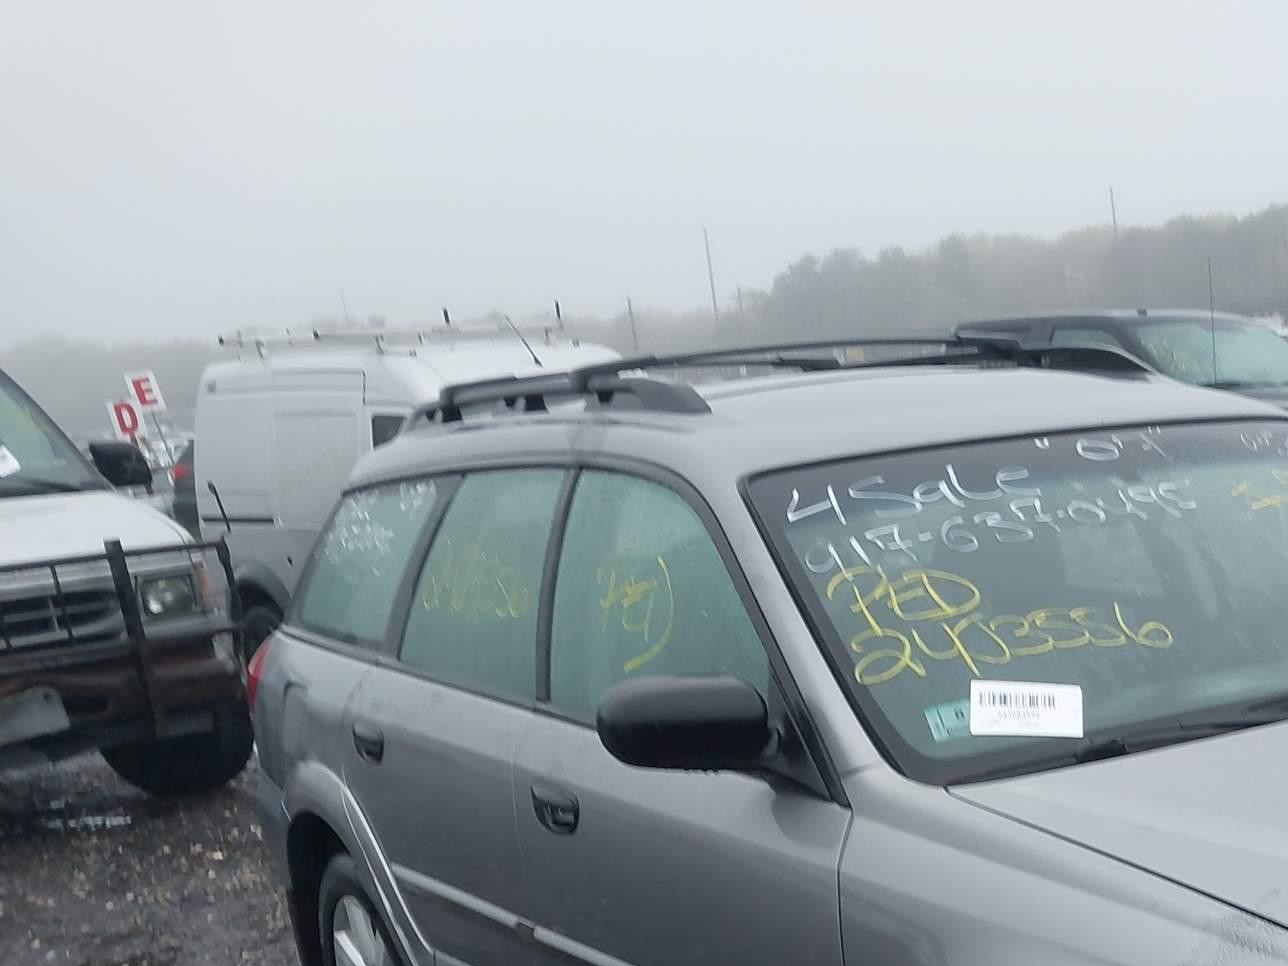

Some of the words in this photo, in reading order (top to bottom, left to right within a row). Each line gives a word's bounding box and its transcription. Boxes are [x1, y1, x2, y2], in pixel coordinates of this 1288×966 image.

[131, 377, 158, 407] E
[113, 402, 139, 434] D
[786, 483, 848, 527] 4
